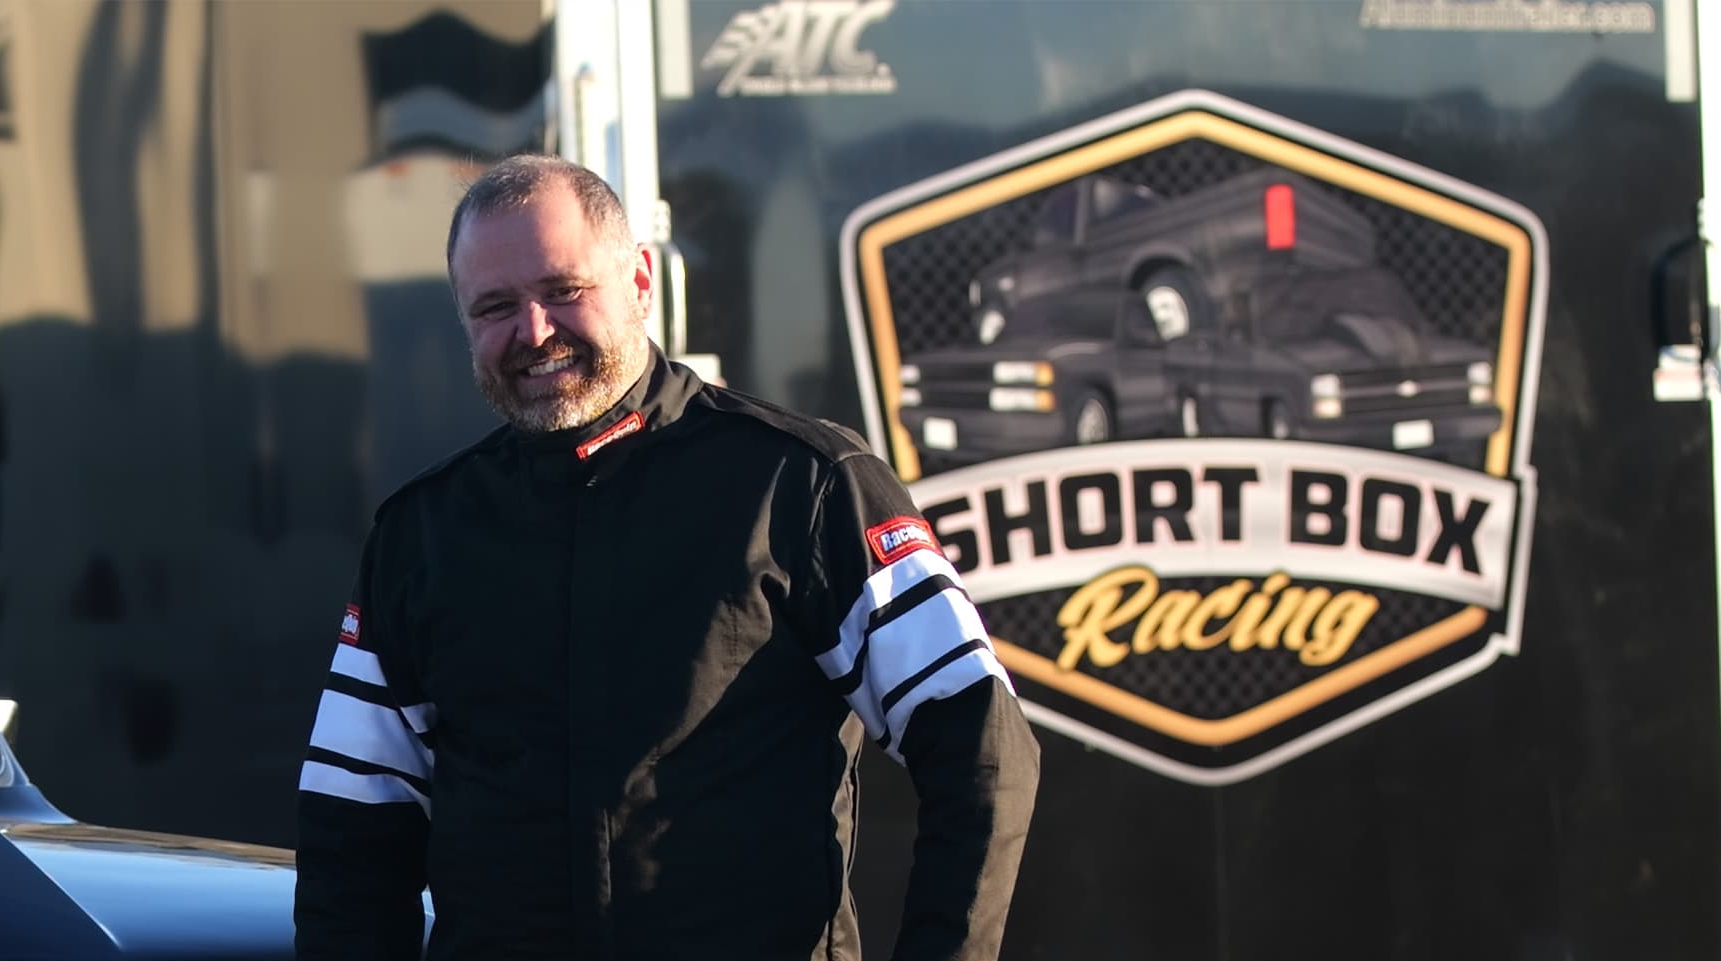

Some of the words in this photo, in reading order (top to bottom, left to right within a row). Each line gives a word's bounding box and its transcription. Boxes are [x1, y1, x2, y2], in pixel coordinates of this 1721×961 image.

[921, 467, 1258, 576] SHORT
[1289, 471, 1491, 575] BOX
[1057, 565, 1379, 671] Racing
